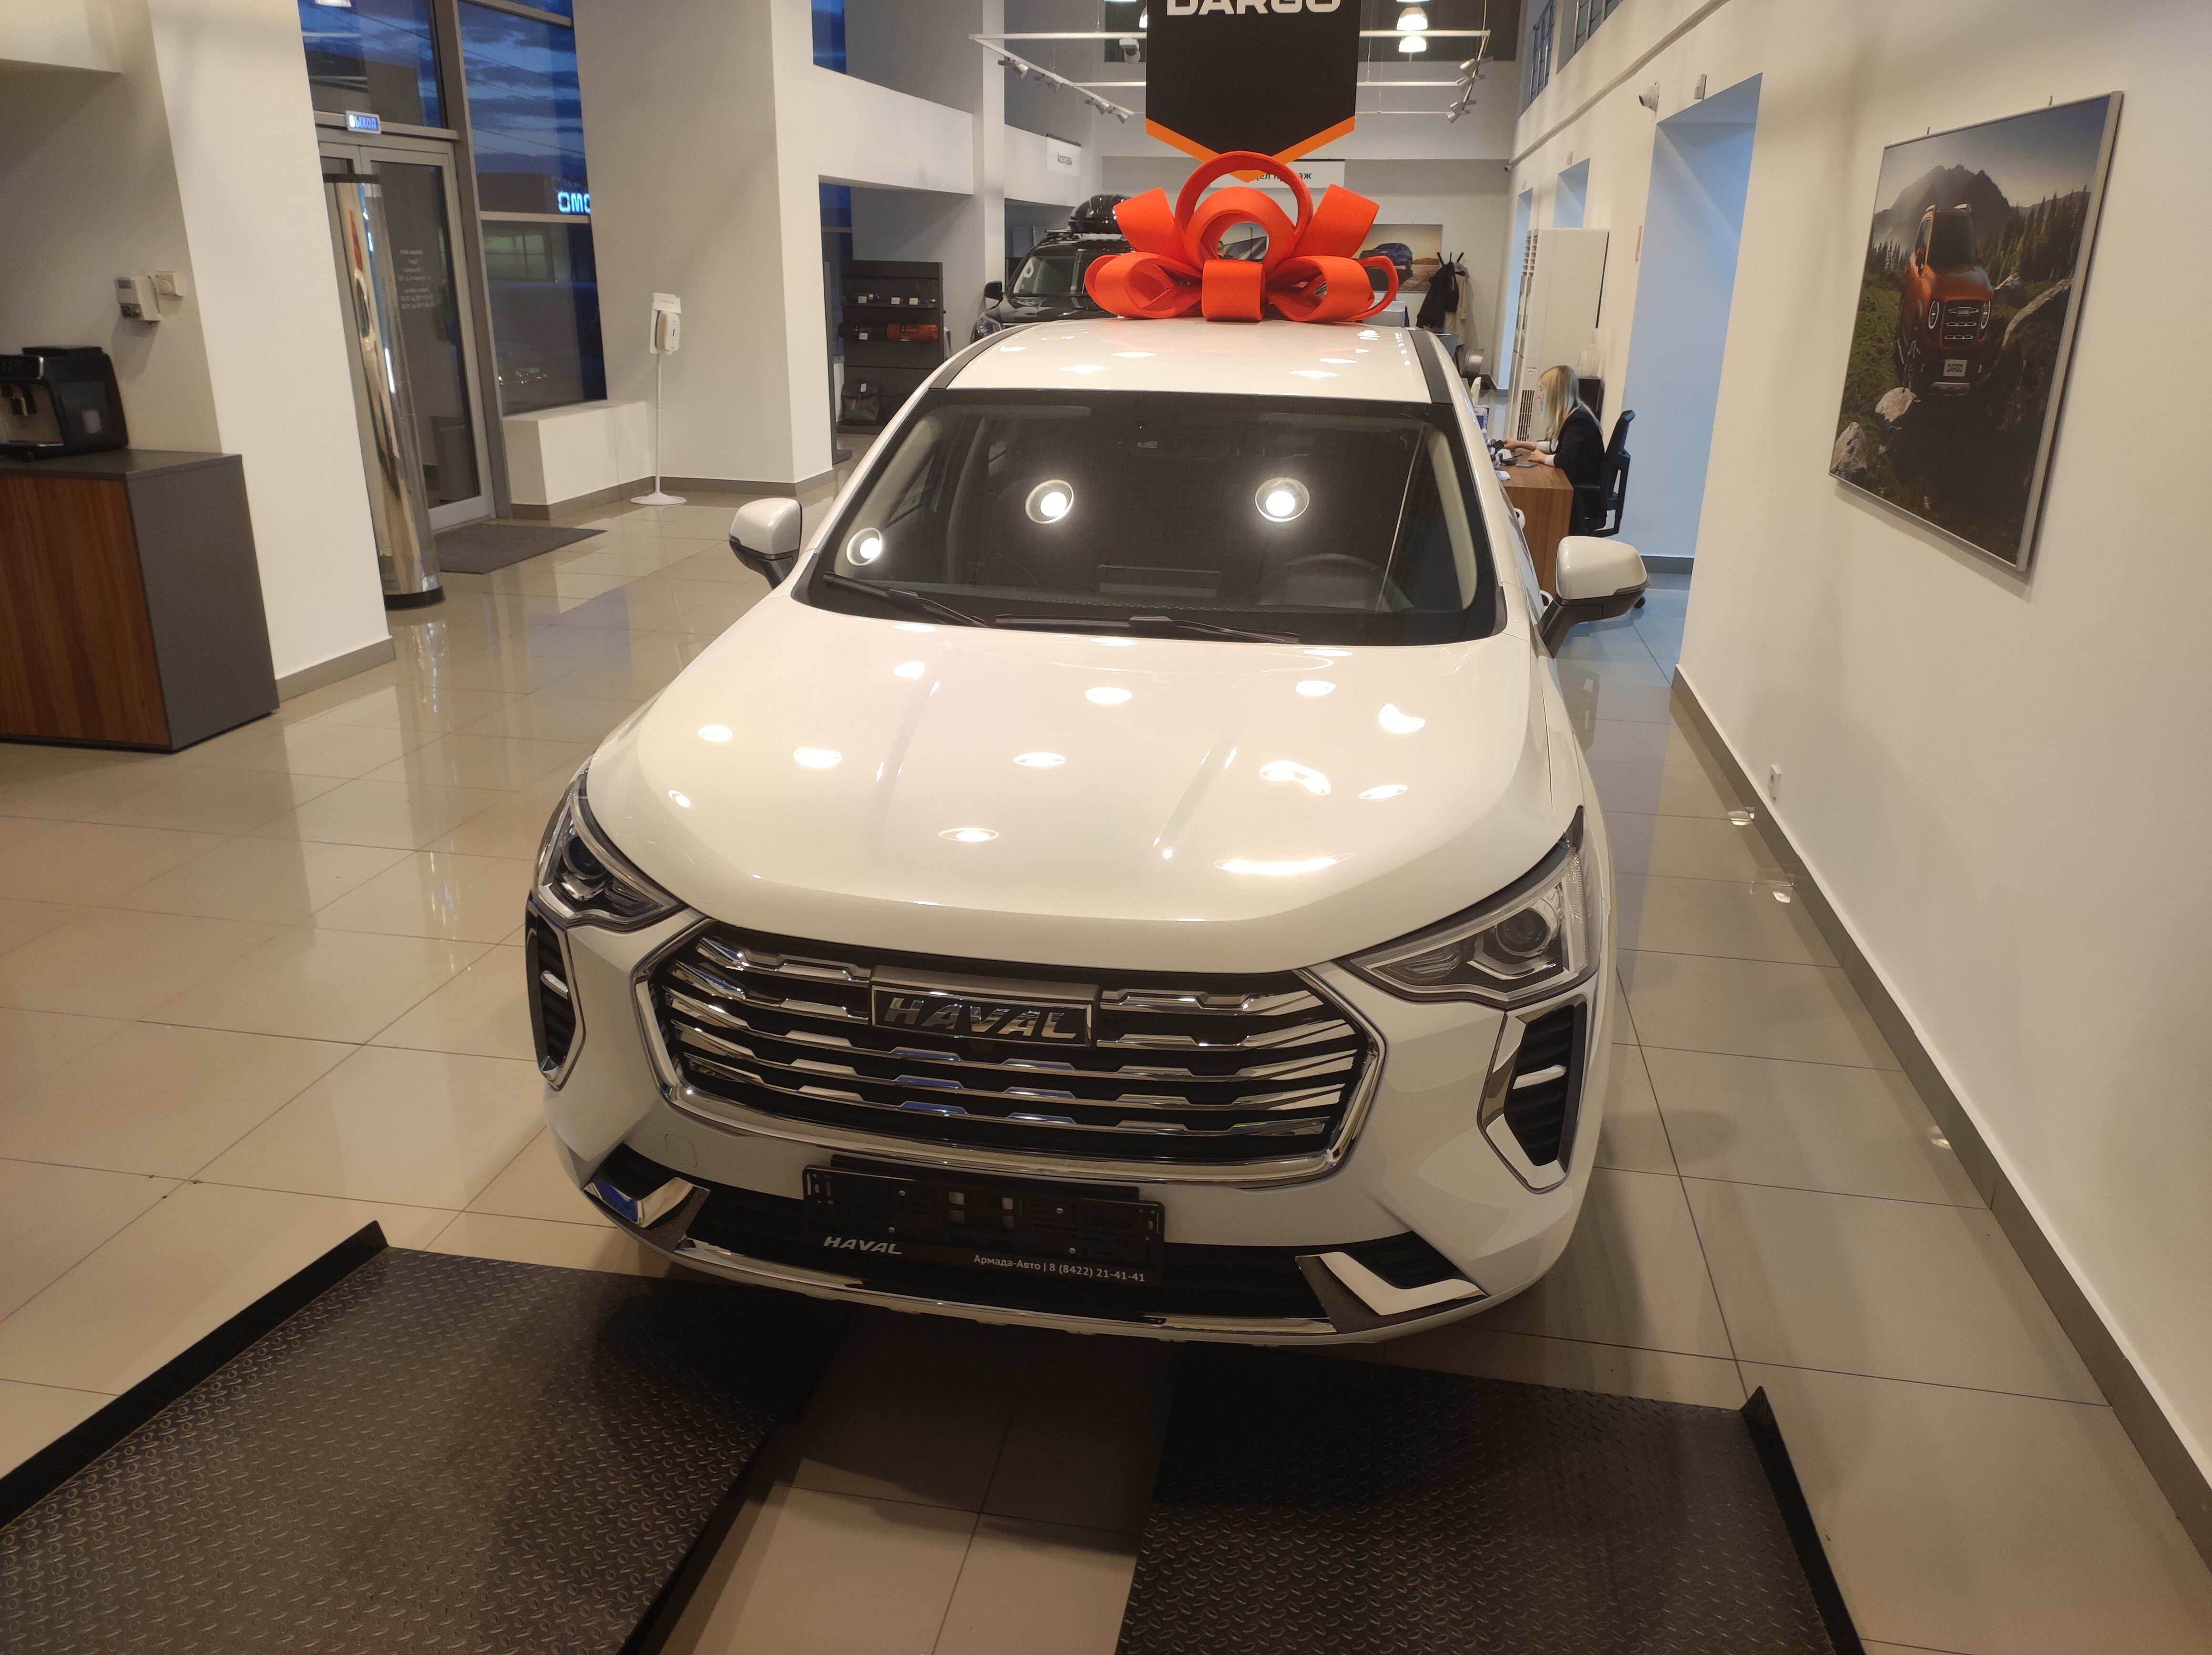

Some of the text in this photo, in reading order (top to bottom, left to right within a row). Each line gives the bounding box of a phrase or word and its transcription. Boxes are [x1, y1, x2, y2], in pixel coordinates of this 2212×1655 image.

[349, 114, 378, 130] ЫХОД
[884, 997, 1076, 1039] HAVAL
[823, 1236, 902, 1255] HAVAL
[973, 1255, 1041, 1270] Армада-Авто
[1049, 1263, 1056, 1272] 8
[1058, 1264, 1093, 1278] (8422)
[1096, 1268, 1146, 1282] 21-41-41
